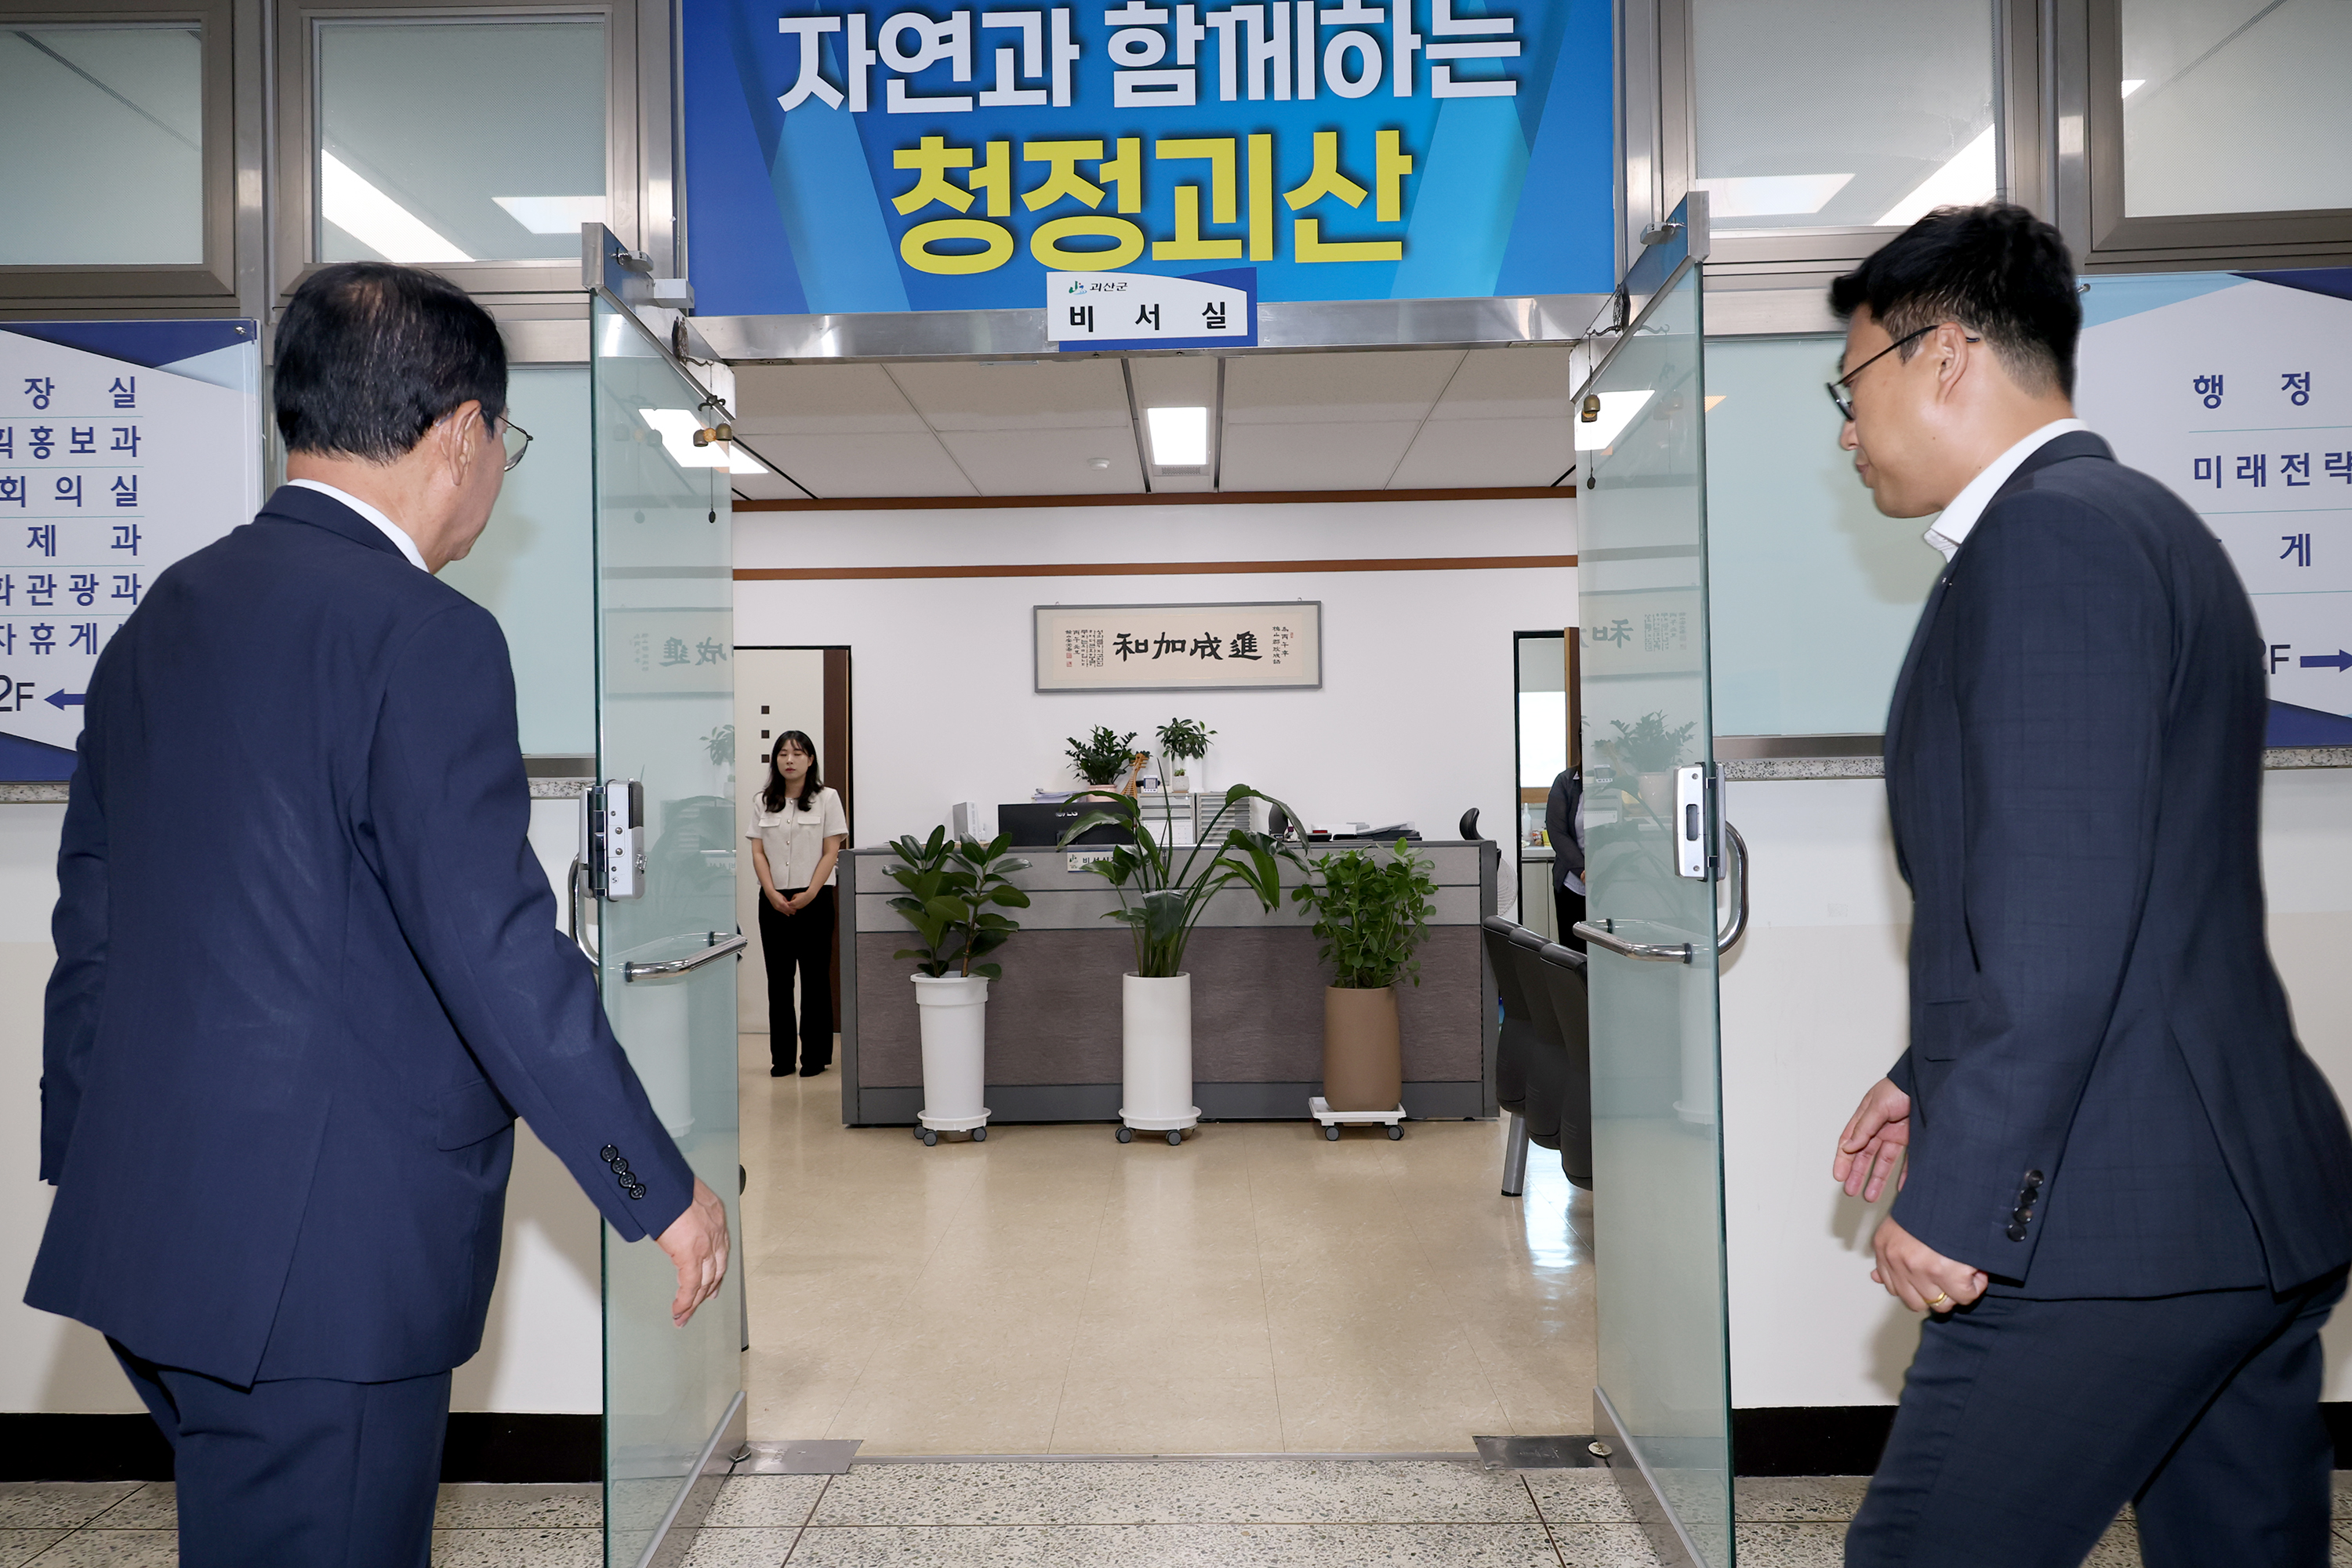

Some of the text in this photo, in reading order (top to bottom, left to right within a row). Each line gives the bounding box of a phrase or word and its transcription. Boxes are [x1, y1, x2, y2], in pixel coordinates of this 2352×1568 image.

[777, 0, 1521, 114] 자연과 함께하는
[891, 129, 1413, 274] 청정괴산
[1090, 281, 1127, 292] 괴산군
[1069, 301, 1226, 332] 비서실
[2194, 451, 2352, 489] 미래전략
[0, 474, 138, 508] 회의실
[0, 674, 35, 713] 2F
